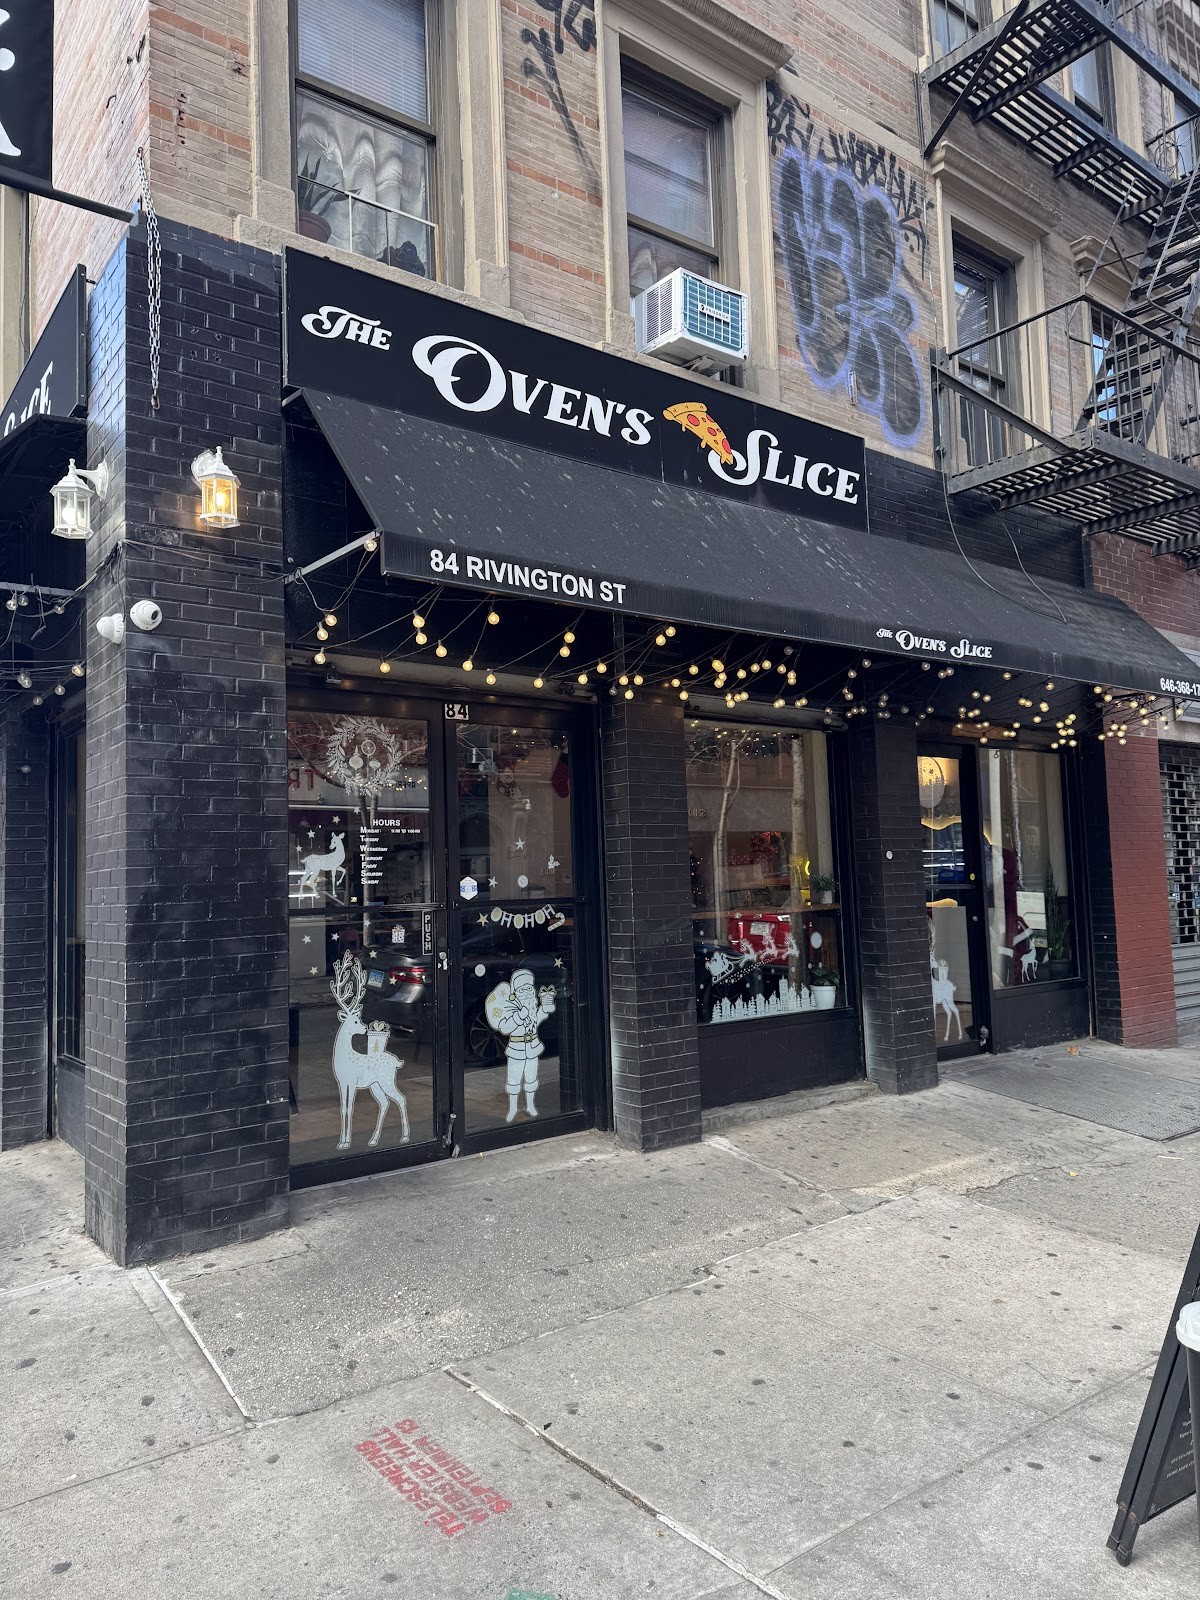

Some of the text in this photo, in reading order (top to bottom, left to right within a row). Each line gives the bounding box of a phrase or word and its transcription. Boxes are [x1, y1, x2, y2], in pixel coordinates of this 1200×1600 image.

[301, 305, 860, 504] THE OVEN'S SLICE
[430, 549, 627, 604] 84 RIVINGTON ST
[876, 628, 993, 658] THE OVEN'S SLICE
[446, 703, 468, 719] 84
[372, 819, 401, 827] HOURS
[424, 914, 432, 951] PUSH
